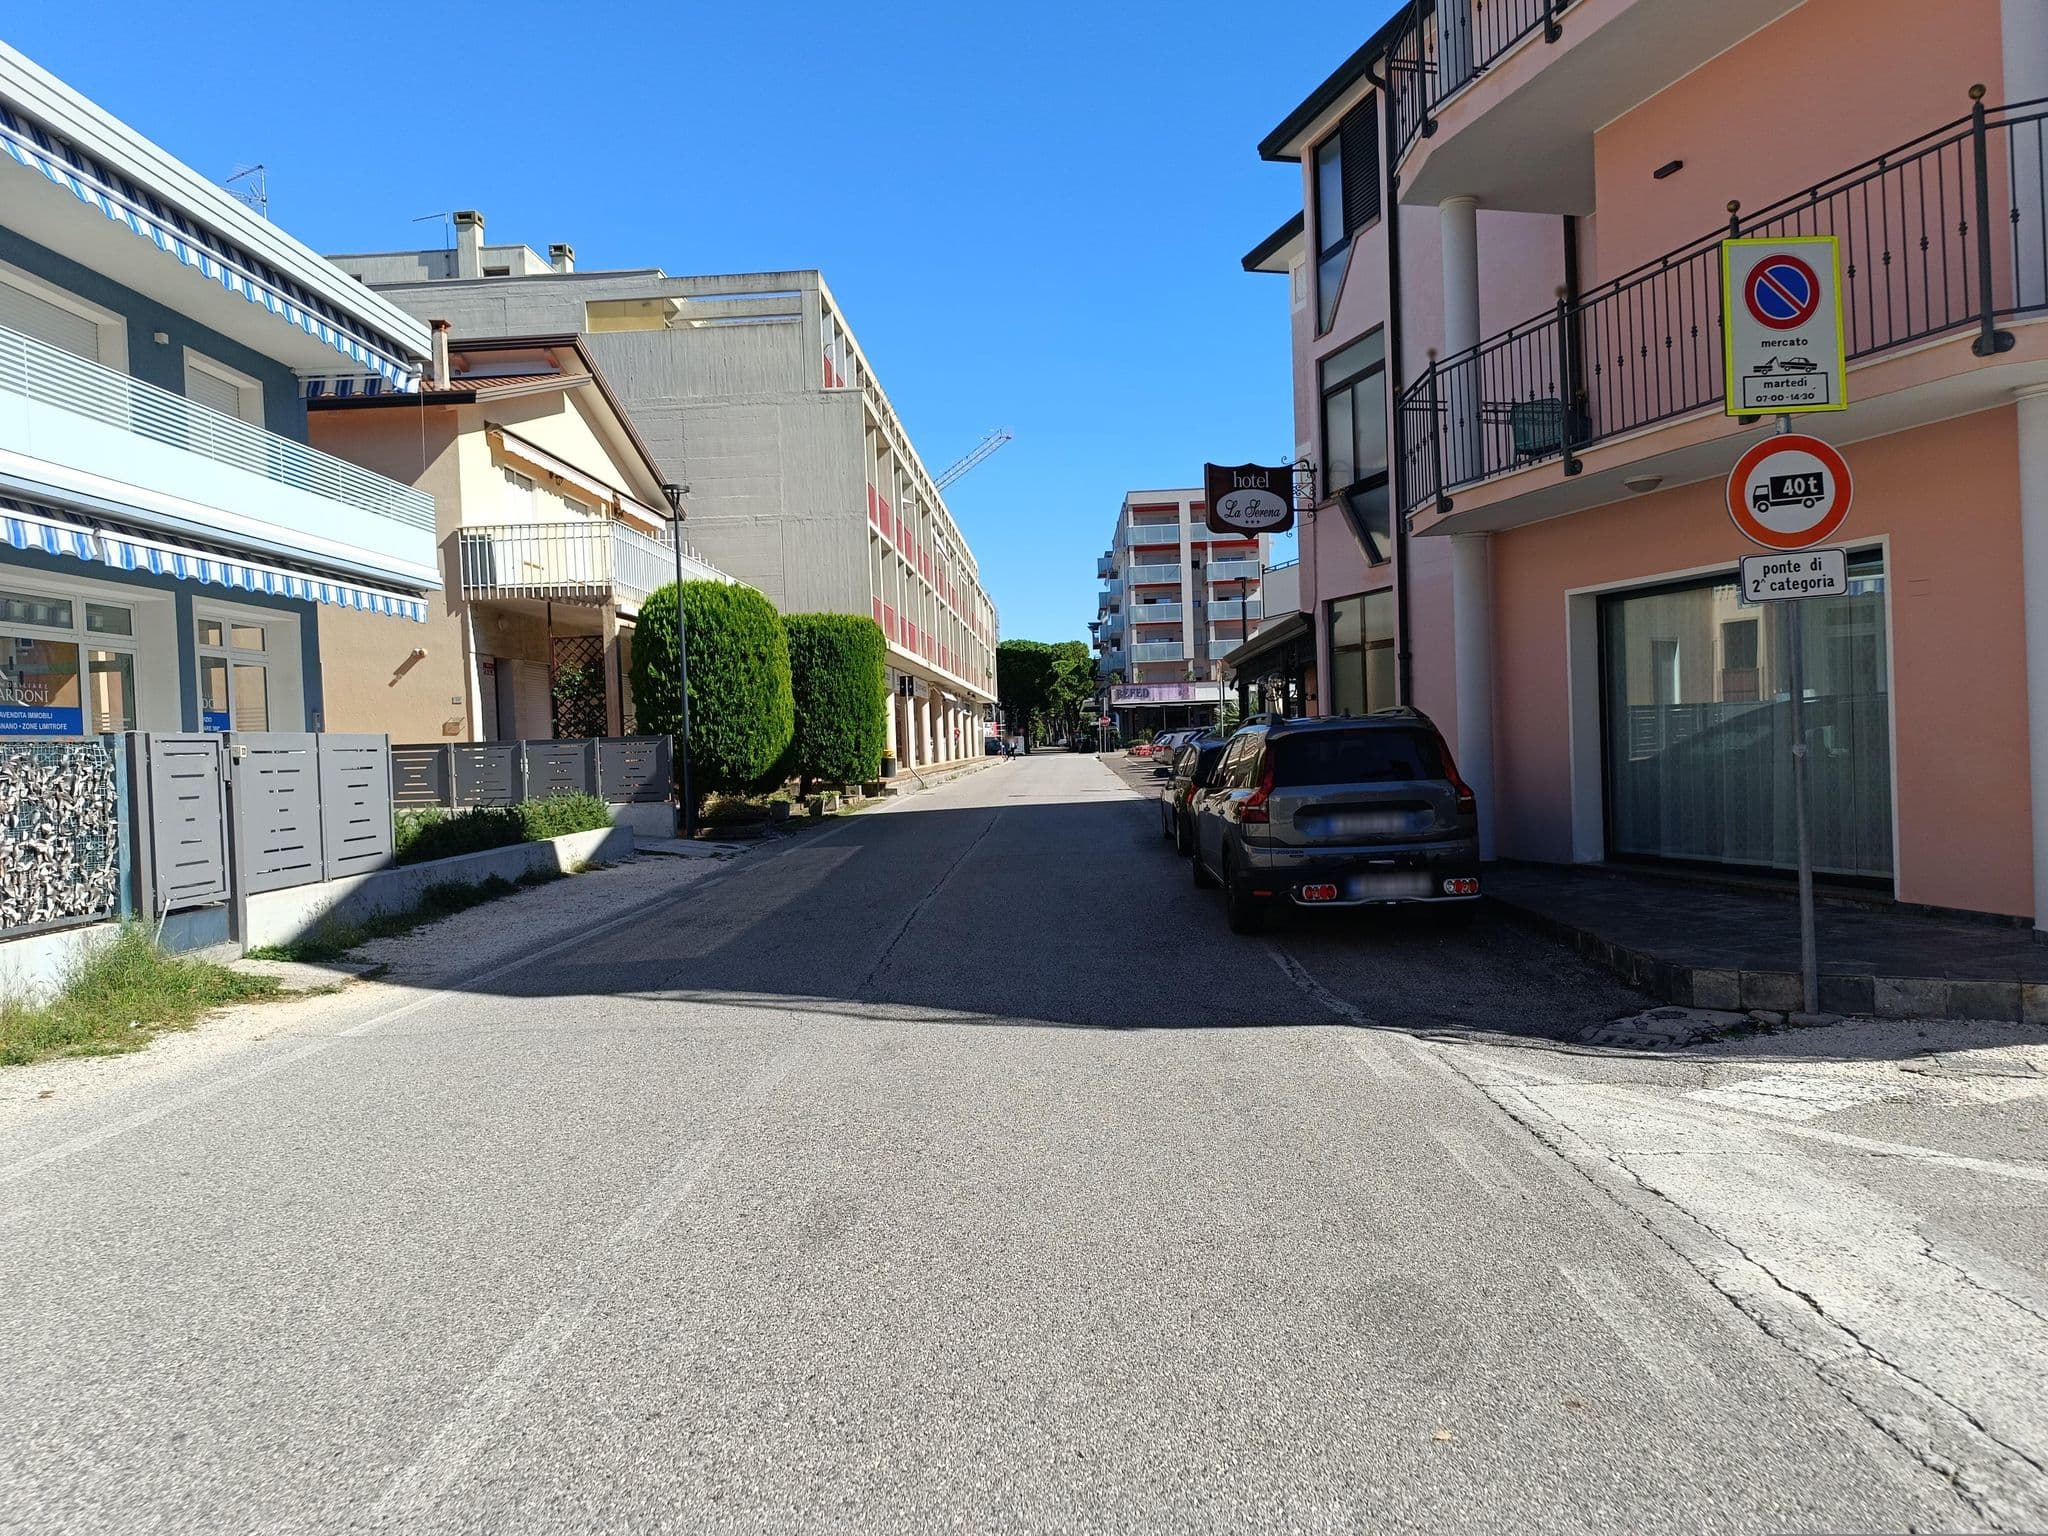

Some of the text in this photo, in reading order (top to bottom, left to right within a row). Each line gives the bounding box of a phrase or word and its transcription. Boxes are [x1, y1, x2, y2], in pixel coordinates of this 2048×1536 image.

[1761, 337, 1808, 348] mercato
[1233, 471, 1269, 488] hotel
[1782, 477, 1805, 495] 40
[1224, 498, 1281, 518] La Serena
[1763, 557, 1822, 578] ponte di
[1769, 574, 1835, 593] categoria
[27, 711, 53, 719] IMMOBILI
[22, 722, 38, 730] ZONE
[38, 722, 68, 730] LIMITROFE
